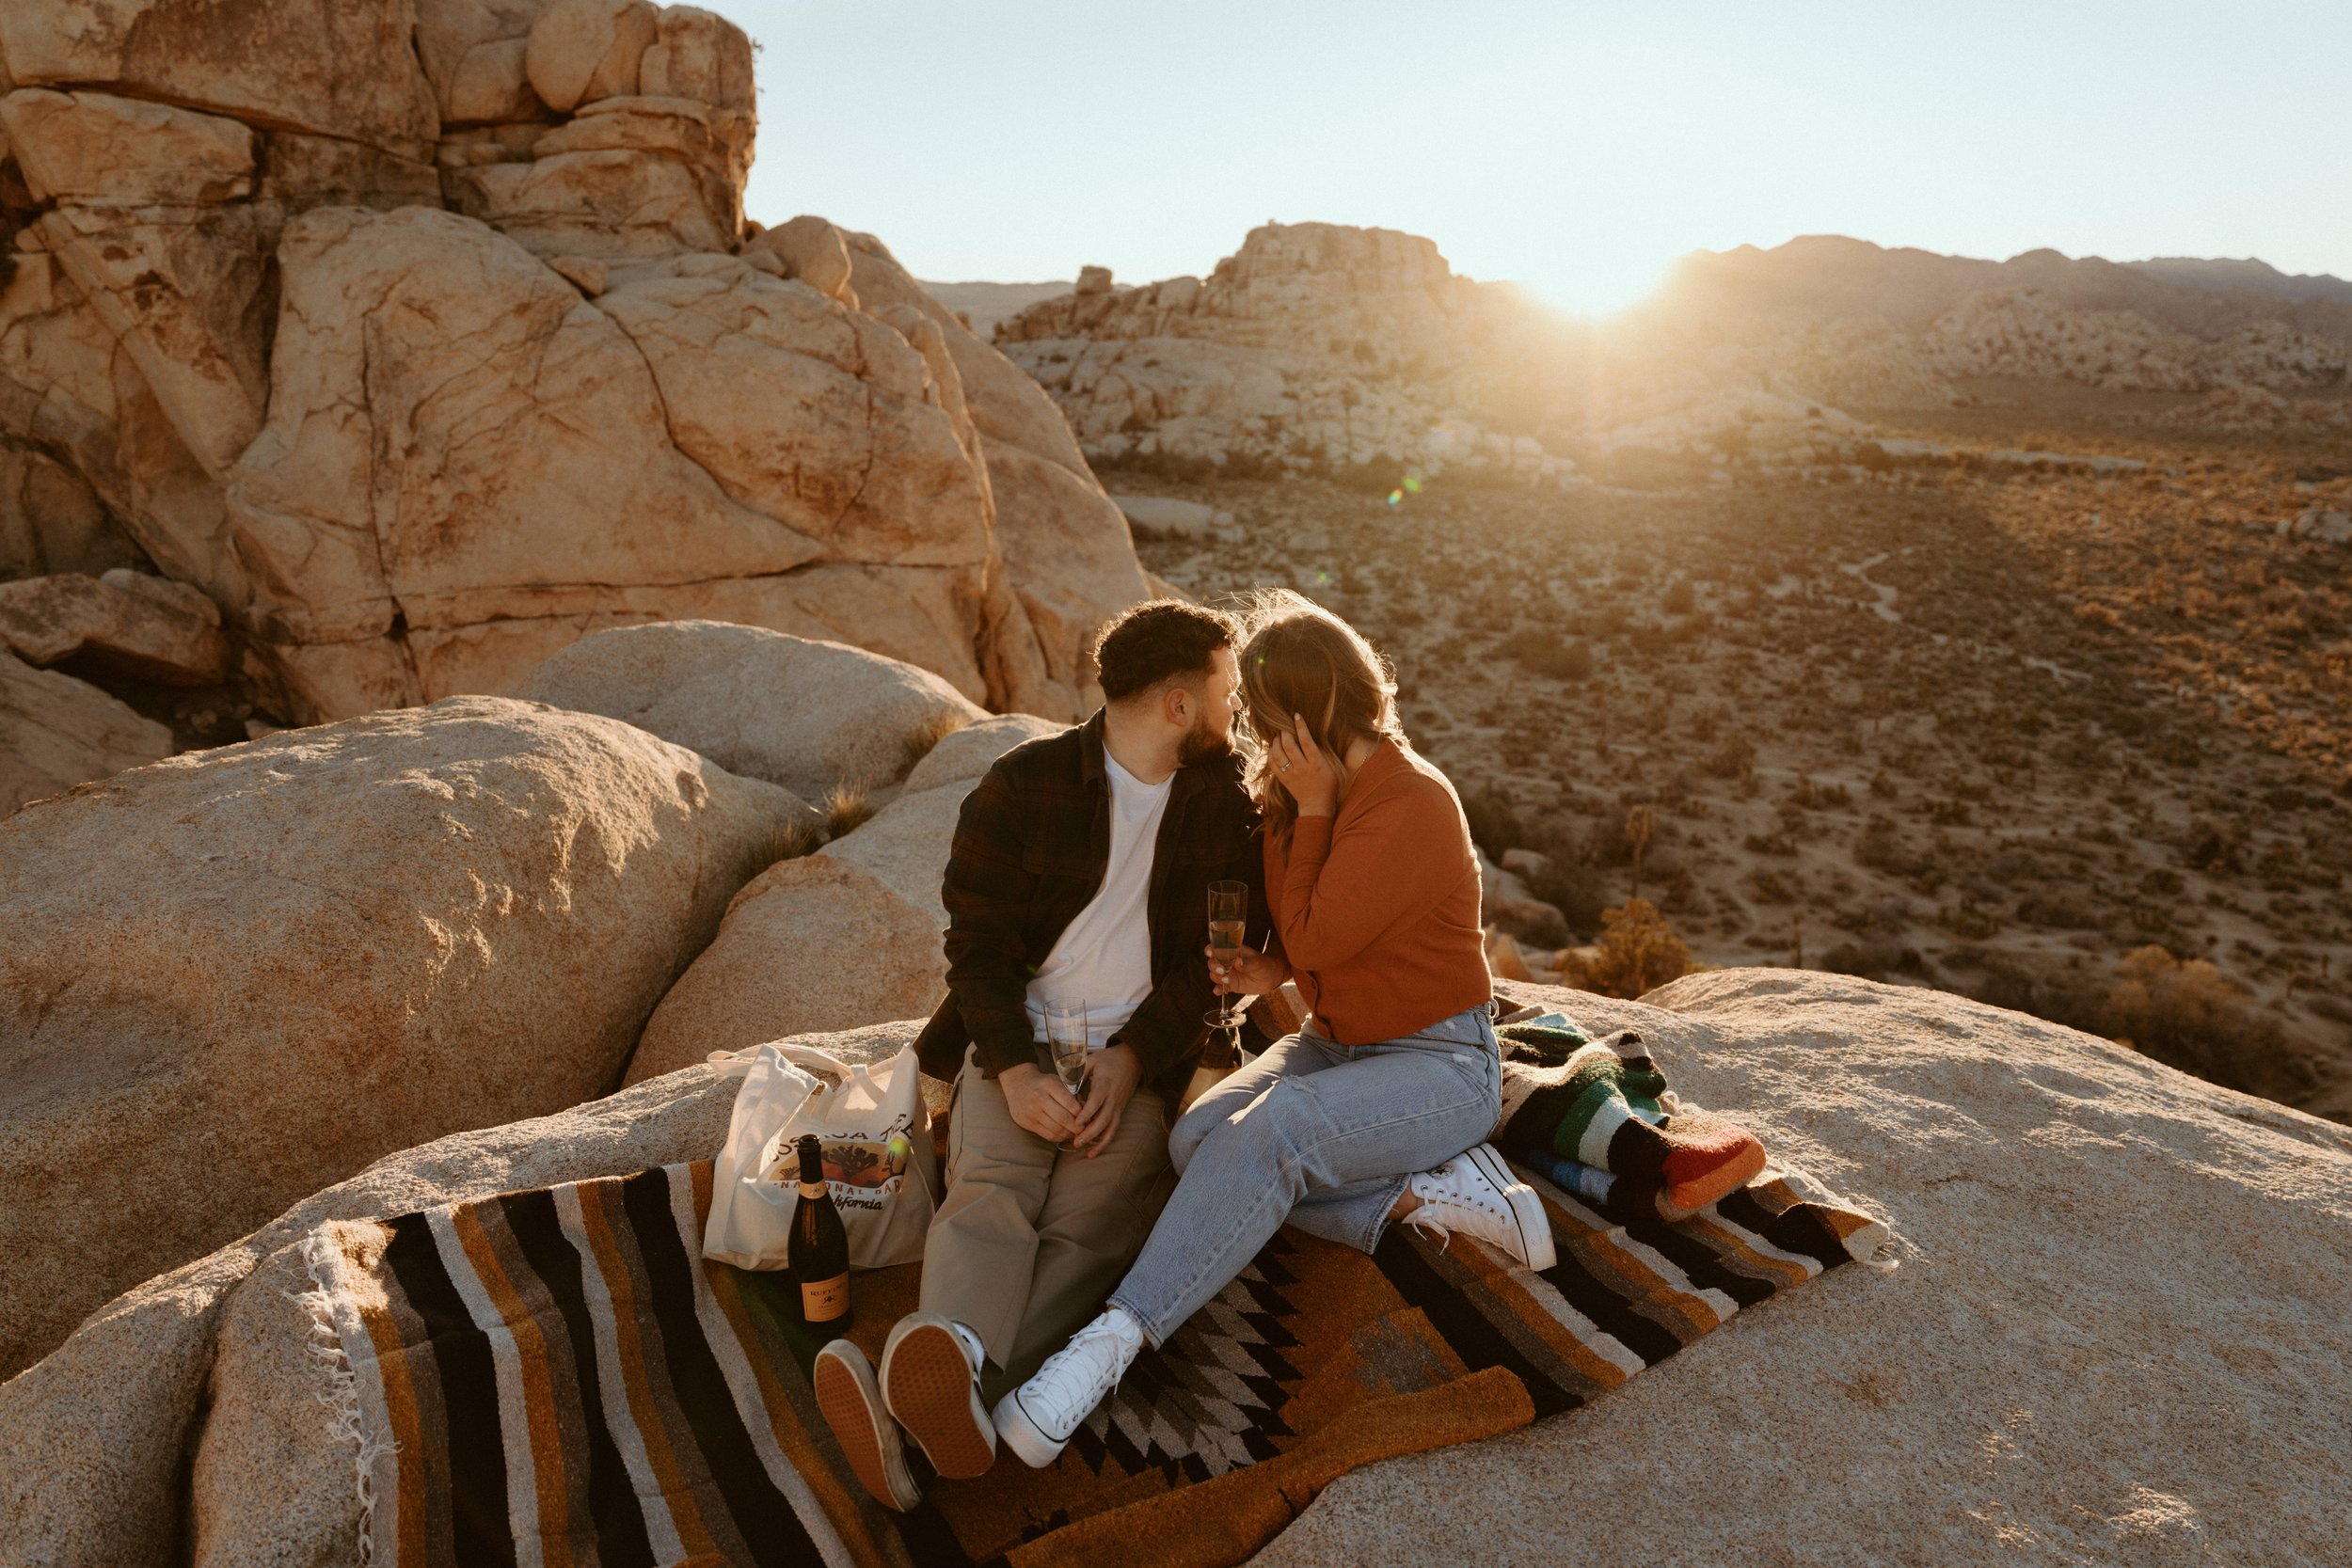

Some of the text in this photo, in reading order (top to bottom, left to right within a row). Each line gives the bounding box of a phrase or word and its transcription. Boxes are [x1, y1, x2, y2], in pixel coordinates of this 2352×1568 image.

[771, 1132, 868, 1162] JOSUA
[780, 1179, 902, 1196] NAONAL PAR
[833, 1194, 883, 1211] lifornia
